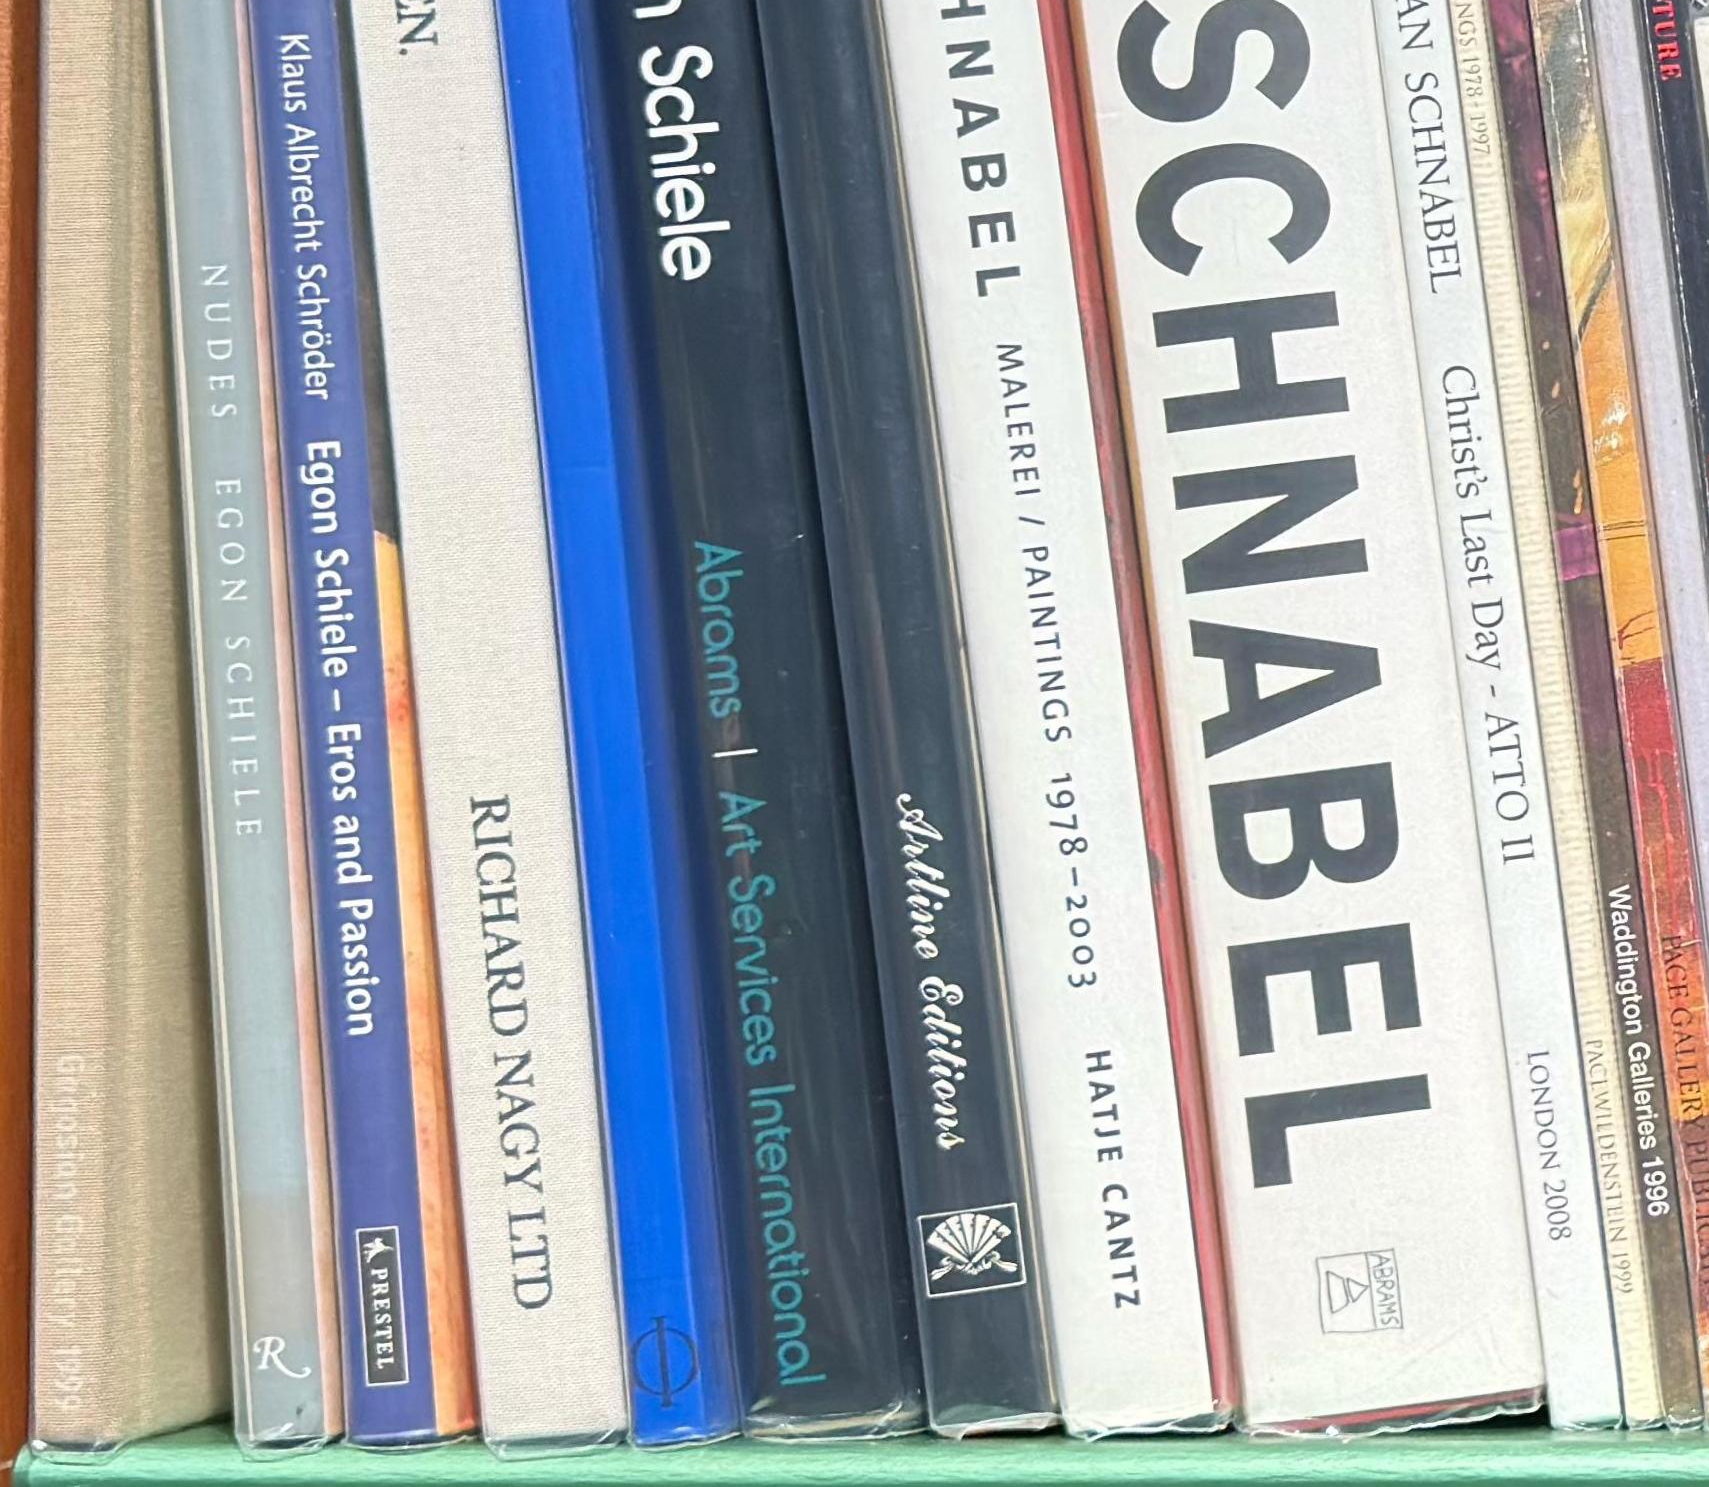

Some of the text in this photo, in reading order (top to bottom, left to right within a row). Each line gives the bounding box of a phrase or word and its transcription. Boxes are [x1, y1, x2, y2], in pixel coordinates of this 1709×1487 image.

[640, 45, 730, 279] Schiele
[1404, 72, 1461, 293] SCHNABEL
[201, 265, 261, 835] NUDES EGON SCHIELE
[280, 34, 379, 1034] Klaus Albrecht Schröder Egon Schiele Eros and Passion
[1460, 510, 1528, 820] Last Day ATTO
[694, 541, 825, 1385] Abrams Art Services International
[896, 793, 966, 1149] Artline Editions
[996, 344, 1139, 1307] MALEREI PAINTINGS HATJE CANTZ
[469, 794, 552, 1309] RICHARD NAGY LTD
[1527, 1051, 1571, 1240] LONDON 2008
[1609, 884, 1669, 1216] Waddington Galleries 1996
[370, 1268, 393, 1368] PRESTEL
